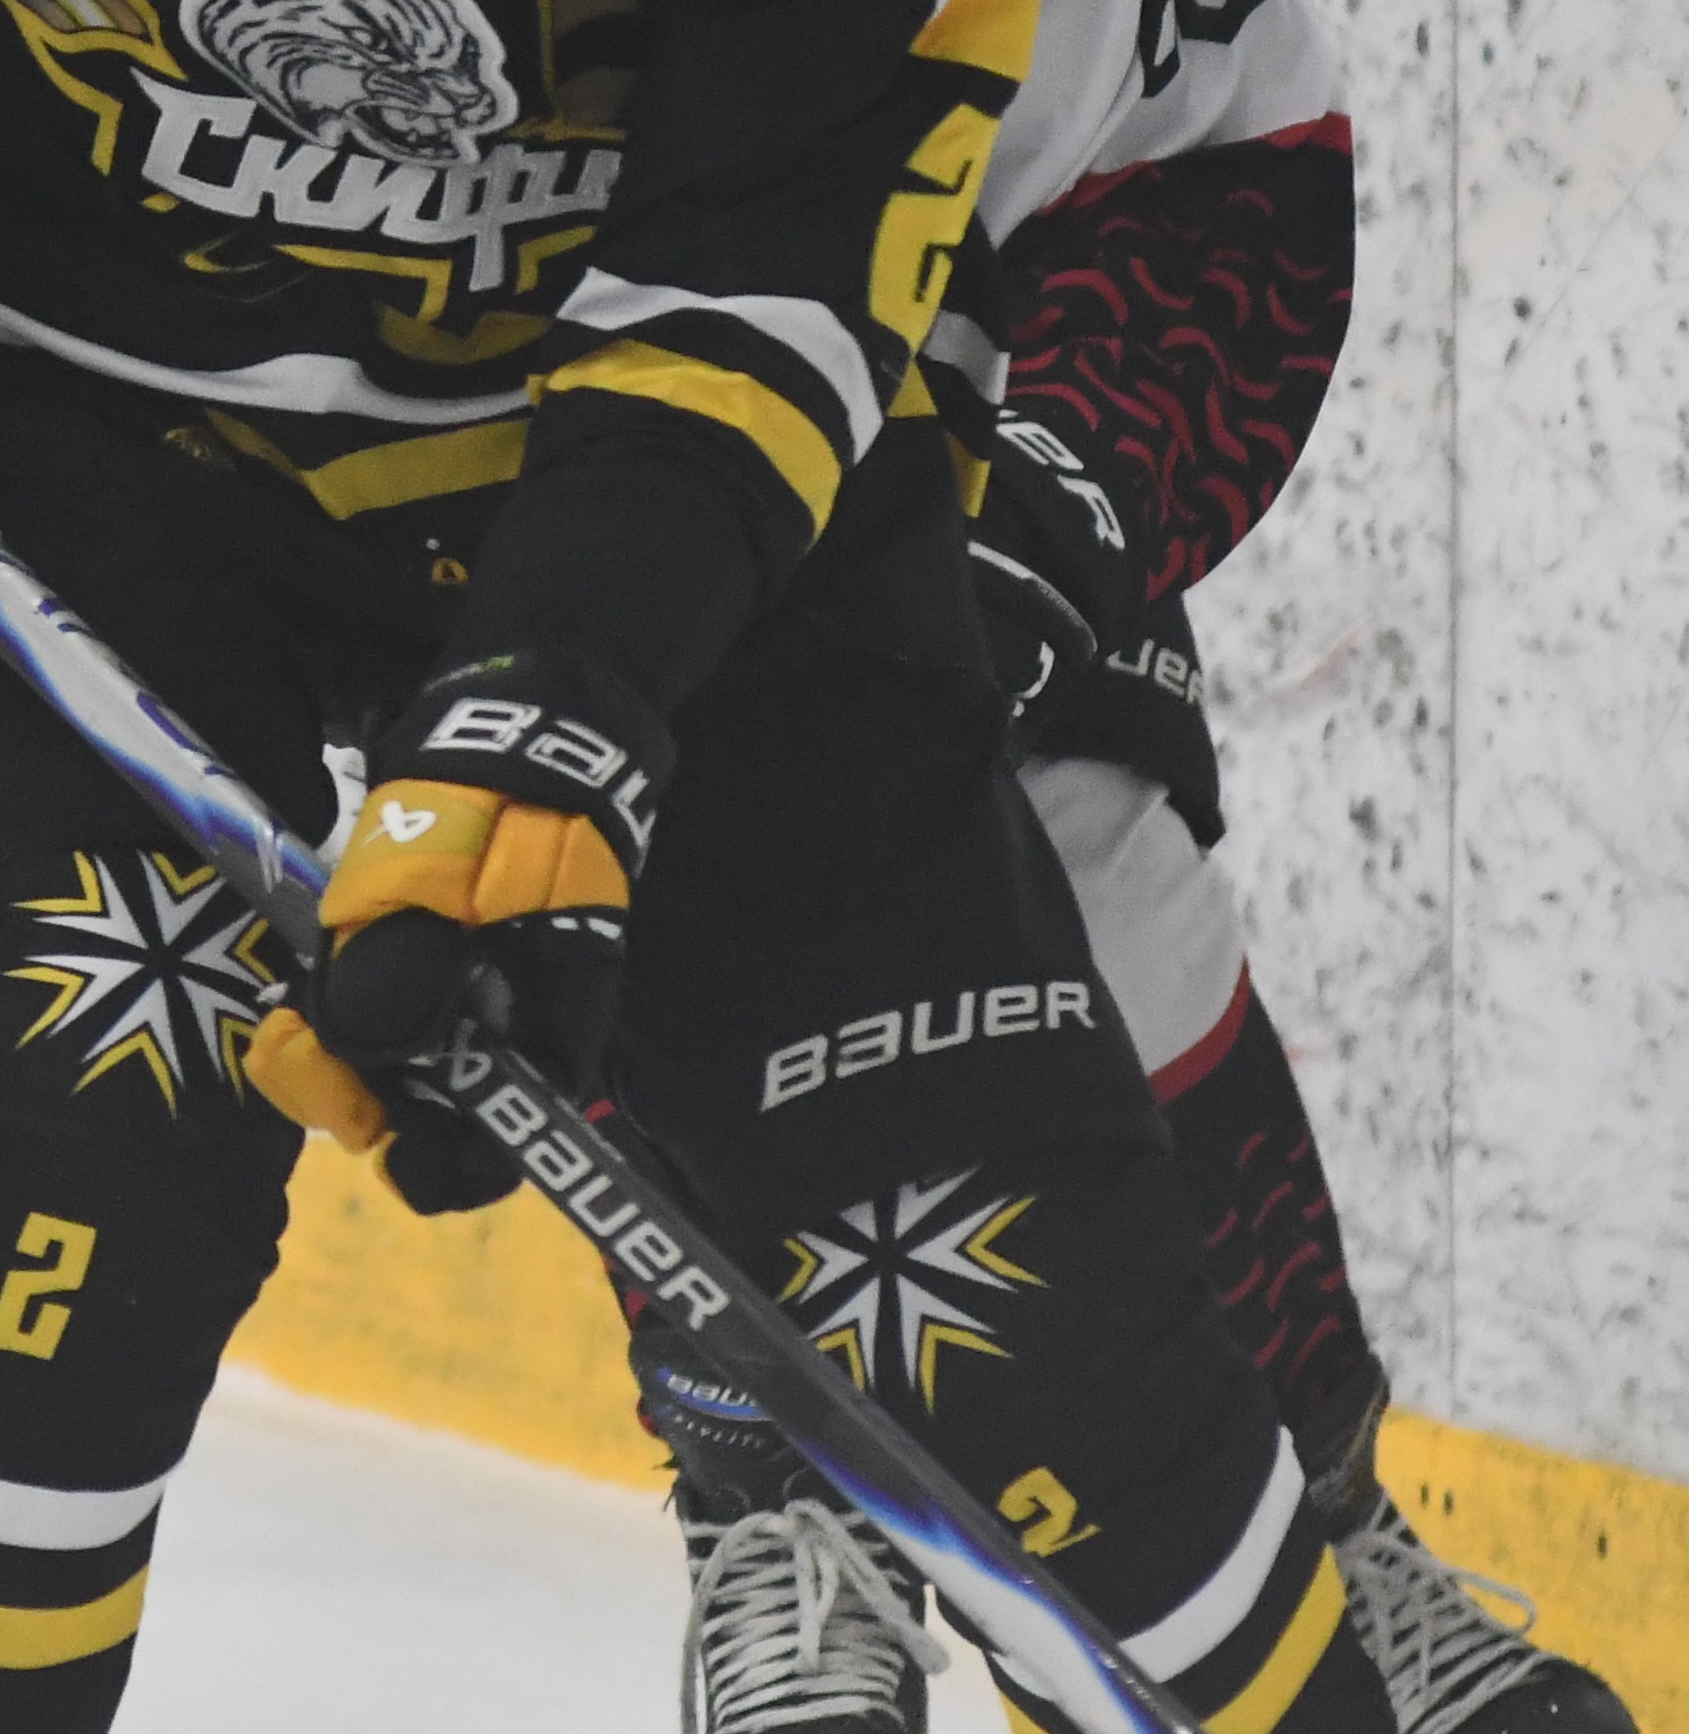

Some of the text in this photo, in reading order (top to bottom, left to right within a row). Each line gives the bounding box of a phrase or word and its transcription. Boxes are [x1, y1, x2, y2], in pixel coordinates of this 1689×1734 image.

[867, 102, 1002, 358] 2
[420, 696, 657, 878] BAU
[759, 980, 1097, 1114] BAUER
[476, 1083, 732, 1332] BAUER
